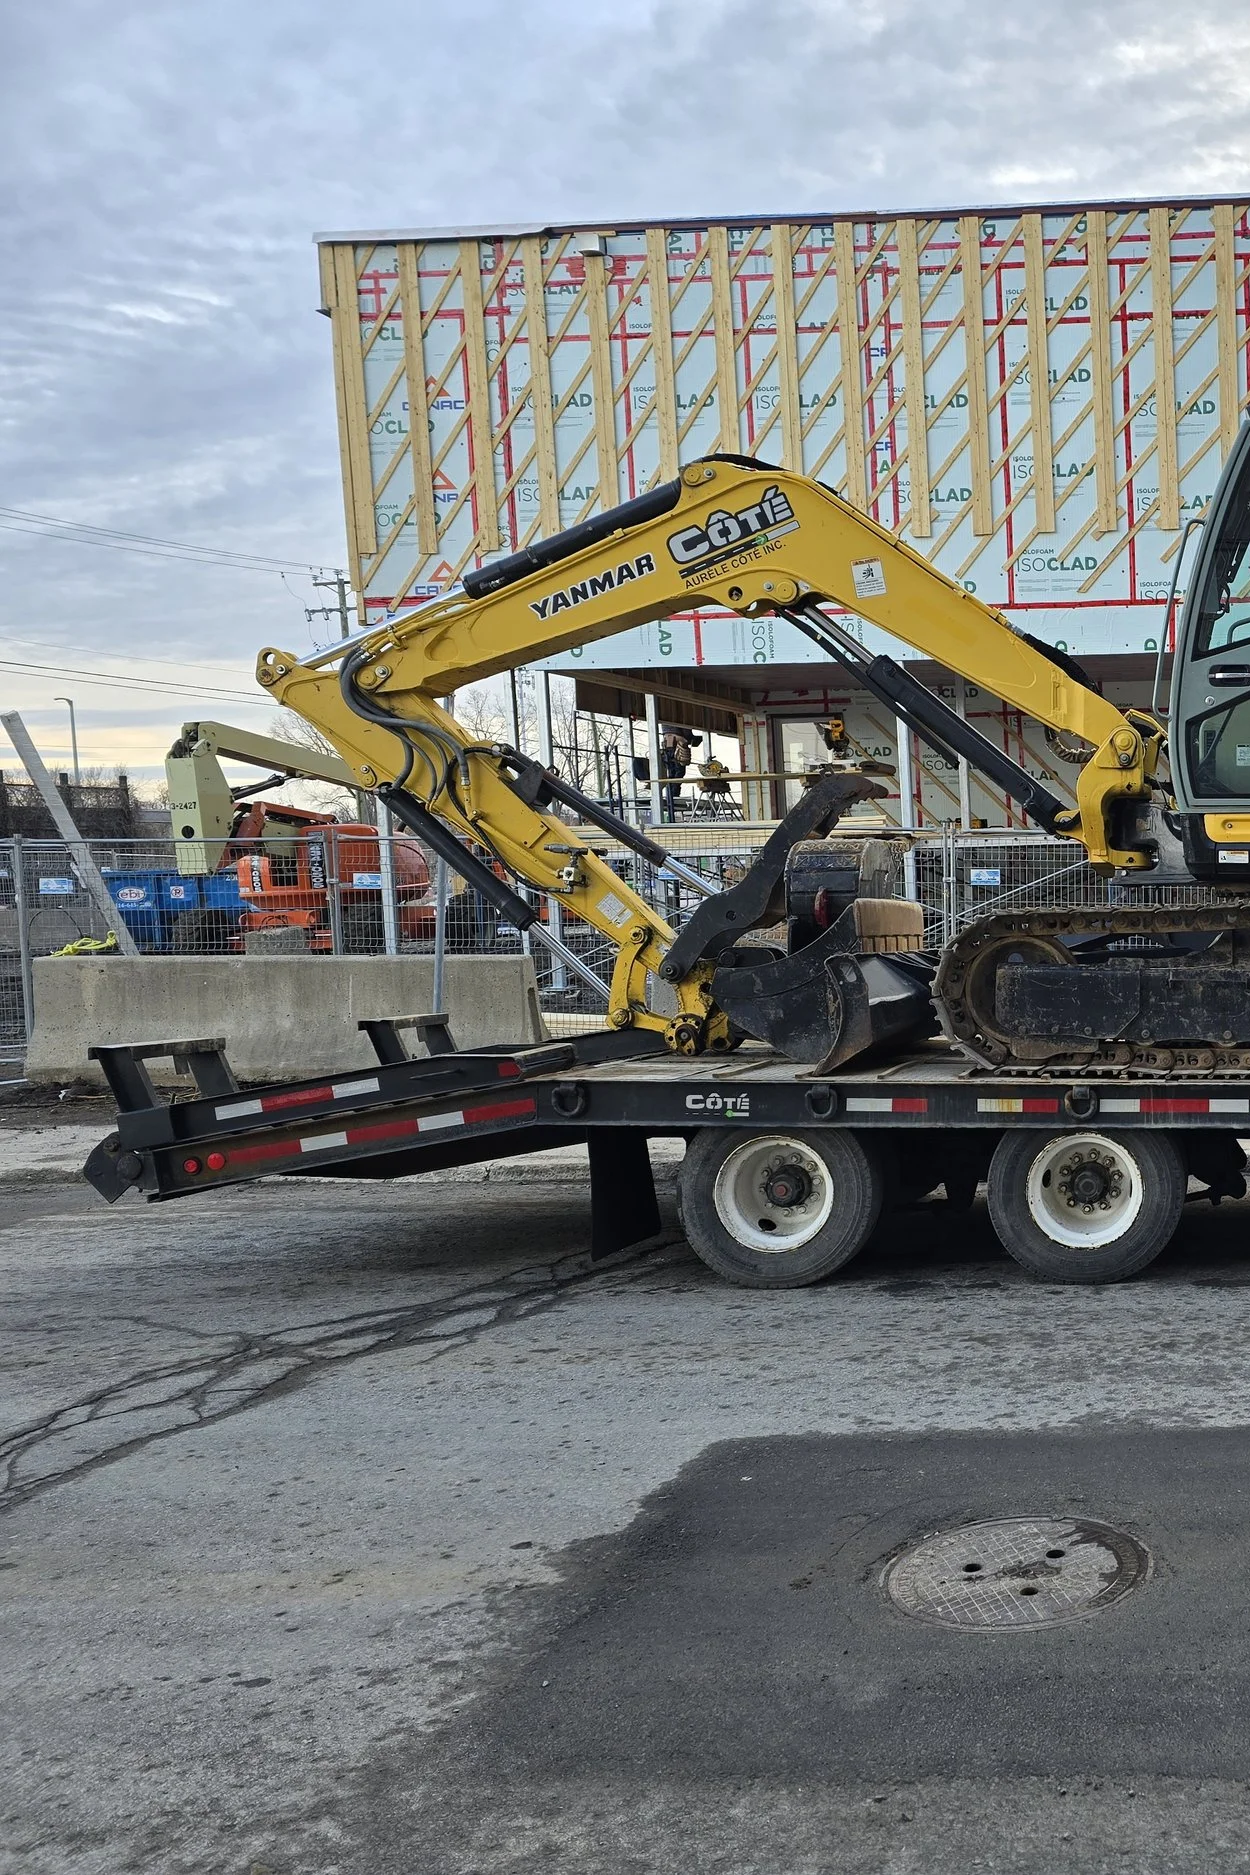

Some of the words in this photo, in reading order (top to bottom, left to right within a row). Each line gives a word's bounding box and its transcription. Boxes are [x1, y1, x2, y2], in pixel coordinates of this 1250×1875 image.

[666, 485, 795, 565] CÔTÉ
[530, 553, 656, 620] YANMAR
[684, 563, 730, 590] AURÈLE
[731, 547, 762, 569] CÔTÉ
[763, 541, 788, 556] INC.
[1017, 556, 1098, 573] ISOCLAD
[685, 1092, 750, 1110] CÔTÉ
